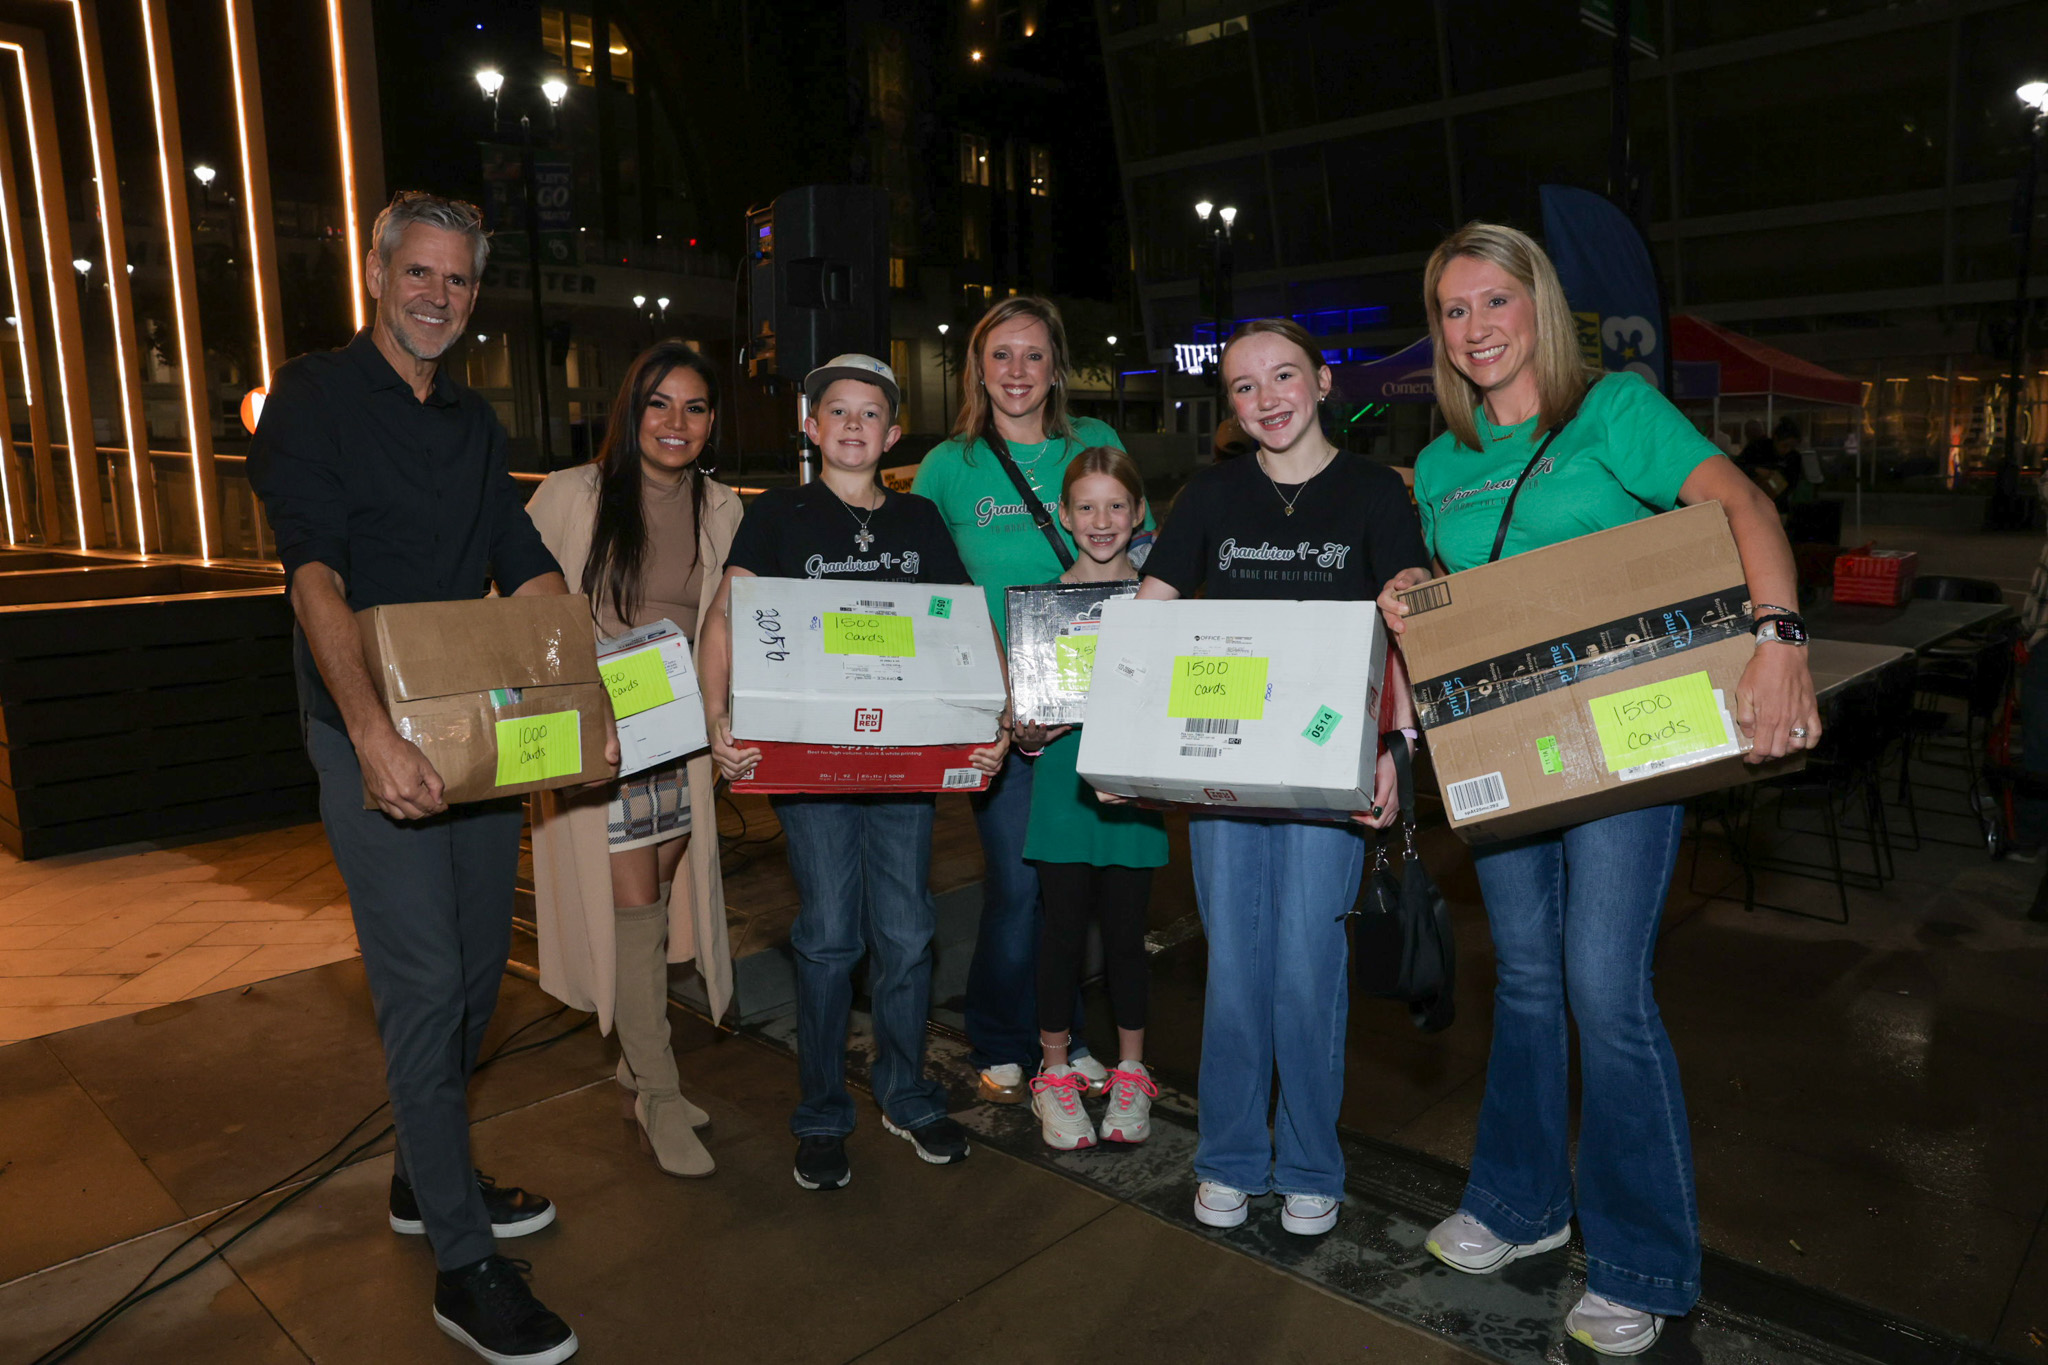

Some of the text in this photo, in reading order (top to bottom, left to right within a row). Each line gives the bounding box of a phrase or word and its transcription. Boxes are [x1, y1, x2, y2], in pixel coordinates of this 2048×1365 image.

[484, 269, 595, 293] CETER
[975, 496, 1057, 527] Grandw
[805, 551, 920, 579] Grandview 4-H
[1219, 538, 1351, 571] Grandview 4-H
[1240, 569, 1261, 580] MAKE
[1264, 570, 1279, 580] THE
[1281, 571, 1300, 581] BEST
[1303, 571, 1333, 582] BETTER
[835, 616, 880, 629] 1500
[1663, 612, 1687, 649] prime
[1073, 644, 1097, 660] 25
[1600, 631, 1609, 651] elivery
[1186, 661, 1229, 676] 1500
[1489, 662, 1502, 690] steaming
[1550, 645, 1572, 683] prime
[1443, 680, 1464, 717] prime
[1613, 694, 1672, 726] 1500
[519, 725, 547, 747] 1000
[1311, 713, 1333, 738] 0514
